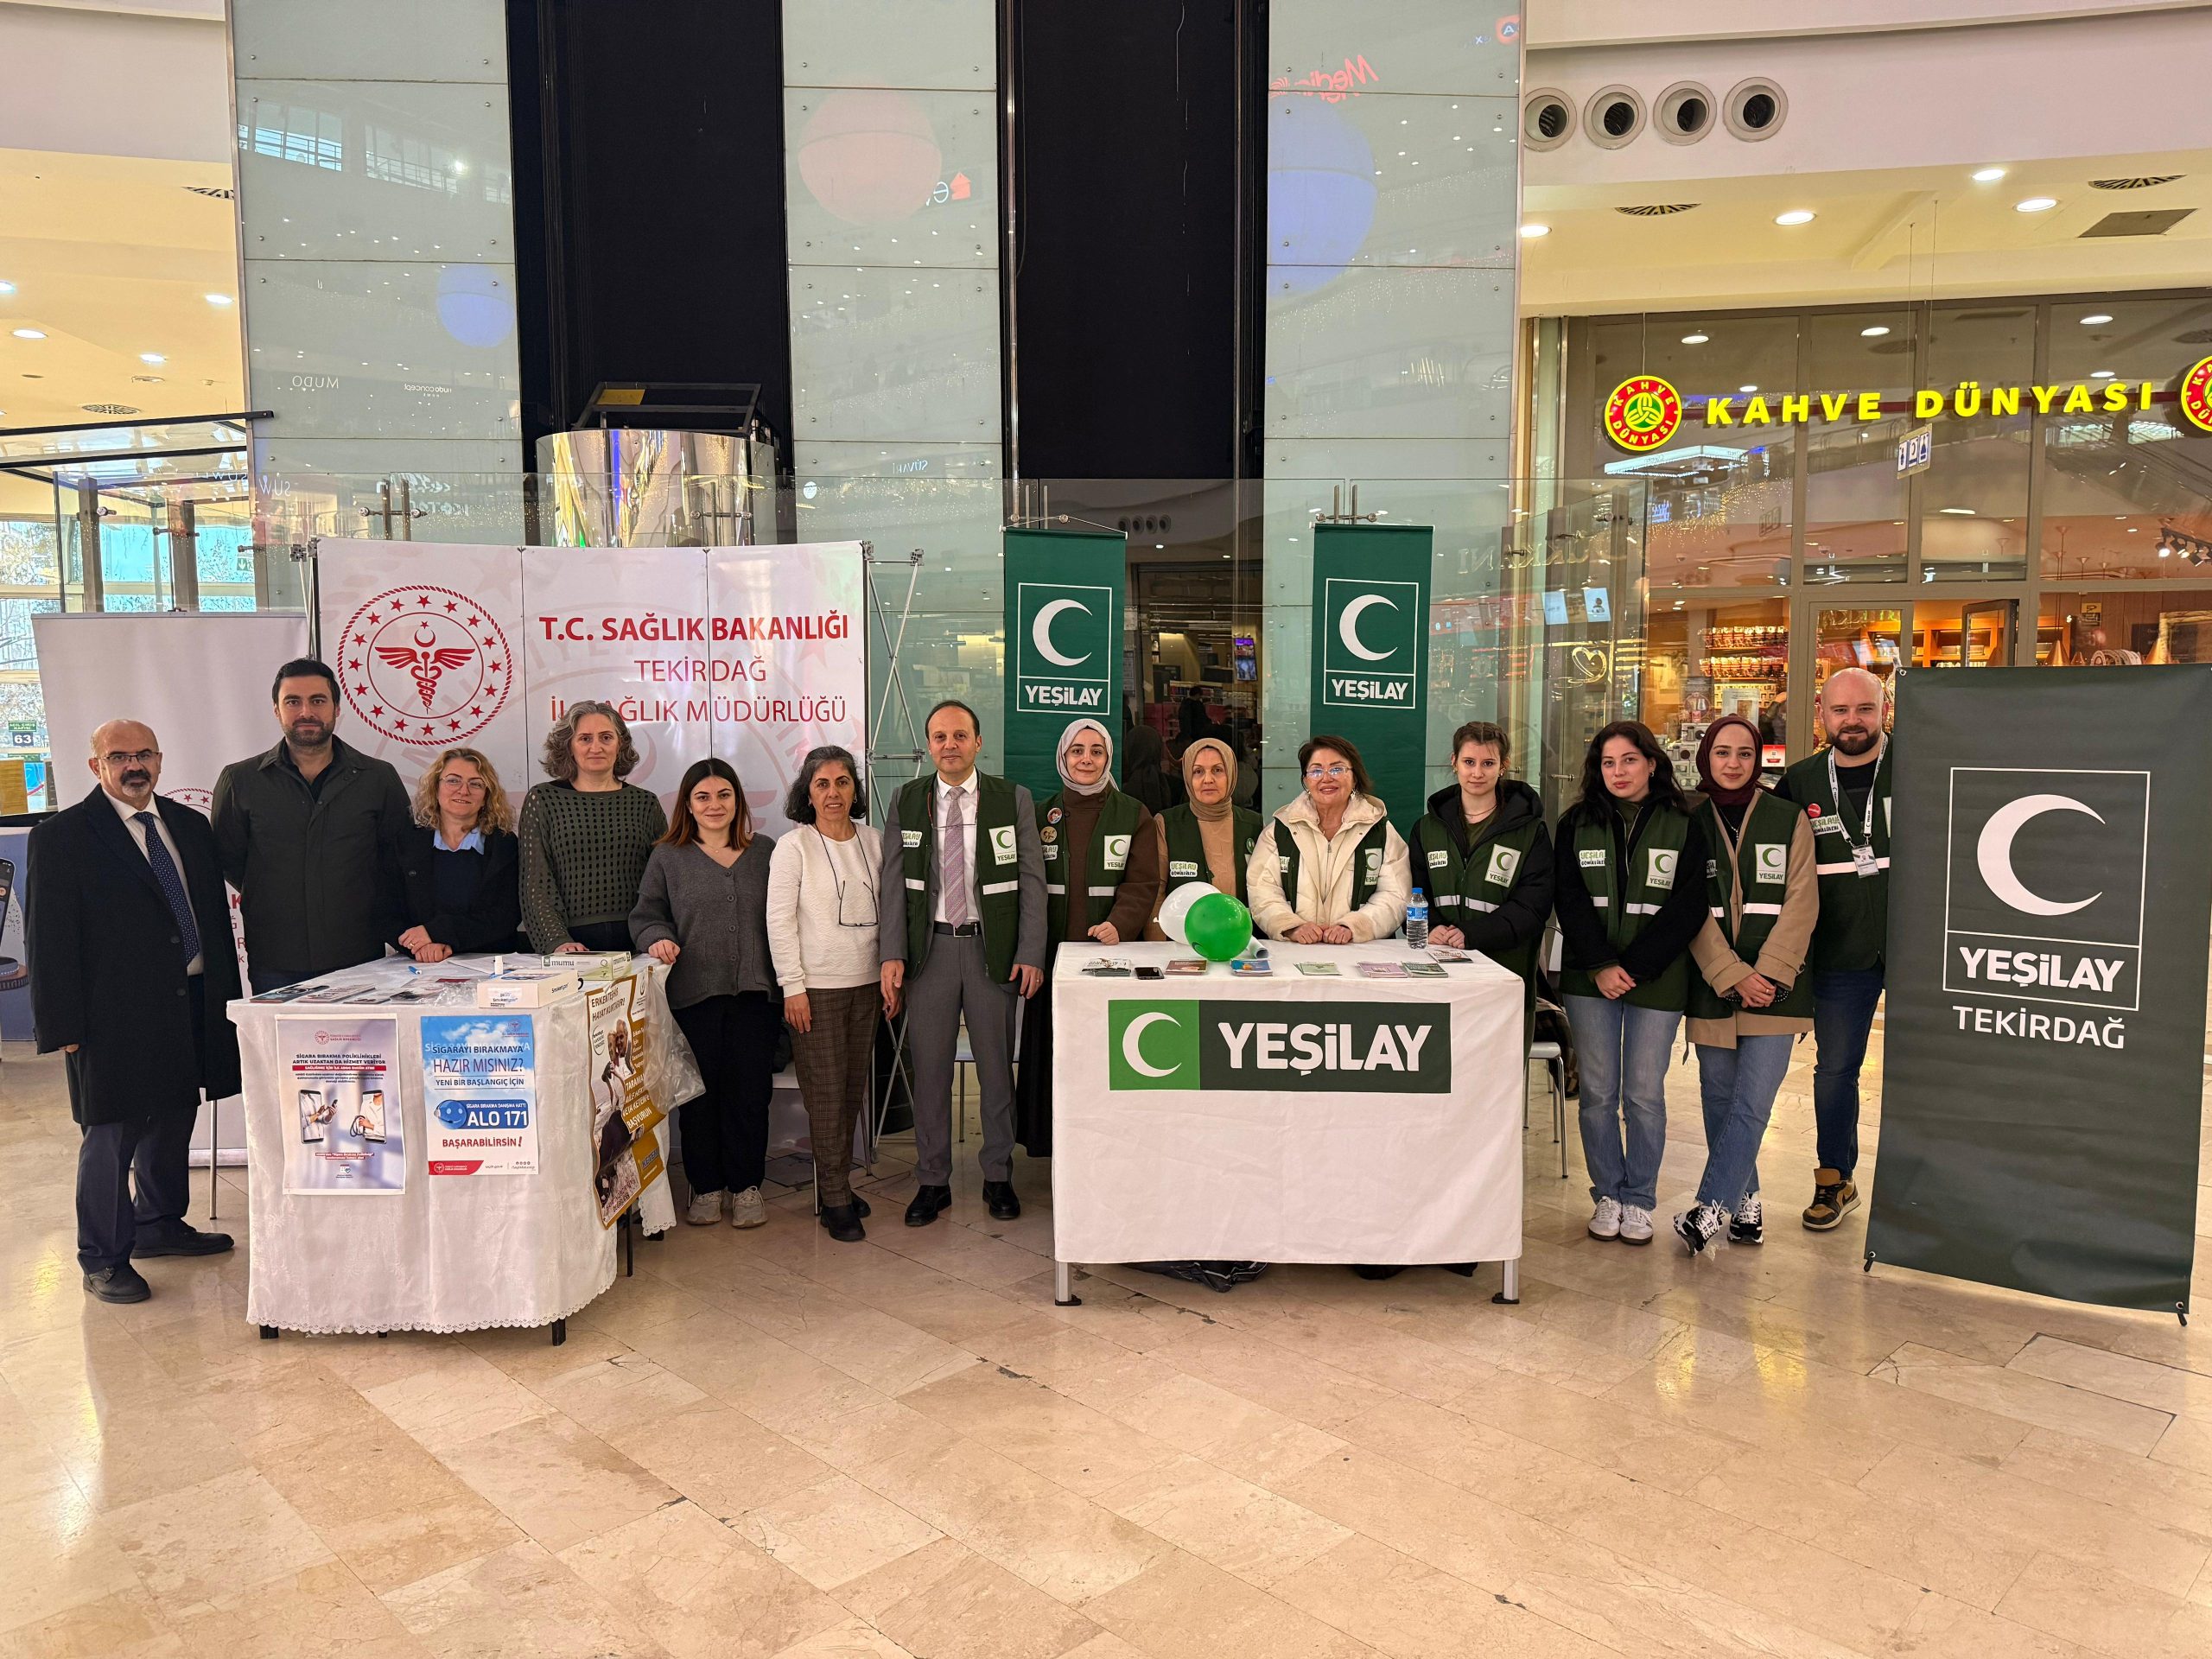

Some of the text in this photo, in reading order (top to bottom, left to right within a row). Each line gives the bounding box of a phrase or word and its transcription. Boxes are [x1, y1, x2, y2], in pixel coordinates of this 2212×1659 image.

[1614, 381, 1675, 406] KAHVE
[1707, 392, 1882, 425] KAHVE
[1916, 380, 2152, 419] DÜNYASI
[1612, 419, 1674, 444] DÜNYASI
[539, 609, 849, 641] T.C. SAĞLIK BAKANLIĞI
[634, 656, 766, 683] TEKİRDAĞ
[687, 696, 846, 722] MÜDÜRLÜĞÜ
[14, 734, 32, 744] 63
[1952, 1005, 2125, 1049] TEKİRDAĞ
[432, 1045, 472, 1054] SİGARAYI
[434, 1058, 524, 1073] HAZIR MISINIZ?
[467, 1078, 508, 1088] BAŞLANGIÇ
[509, 1077, 524, 1088] İÇİN
[467, 1110, 527, 1127] ALO 171
